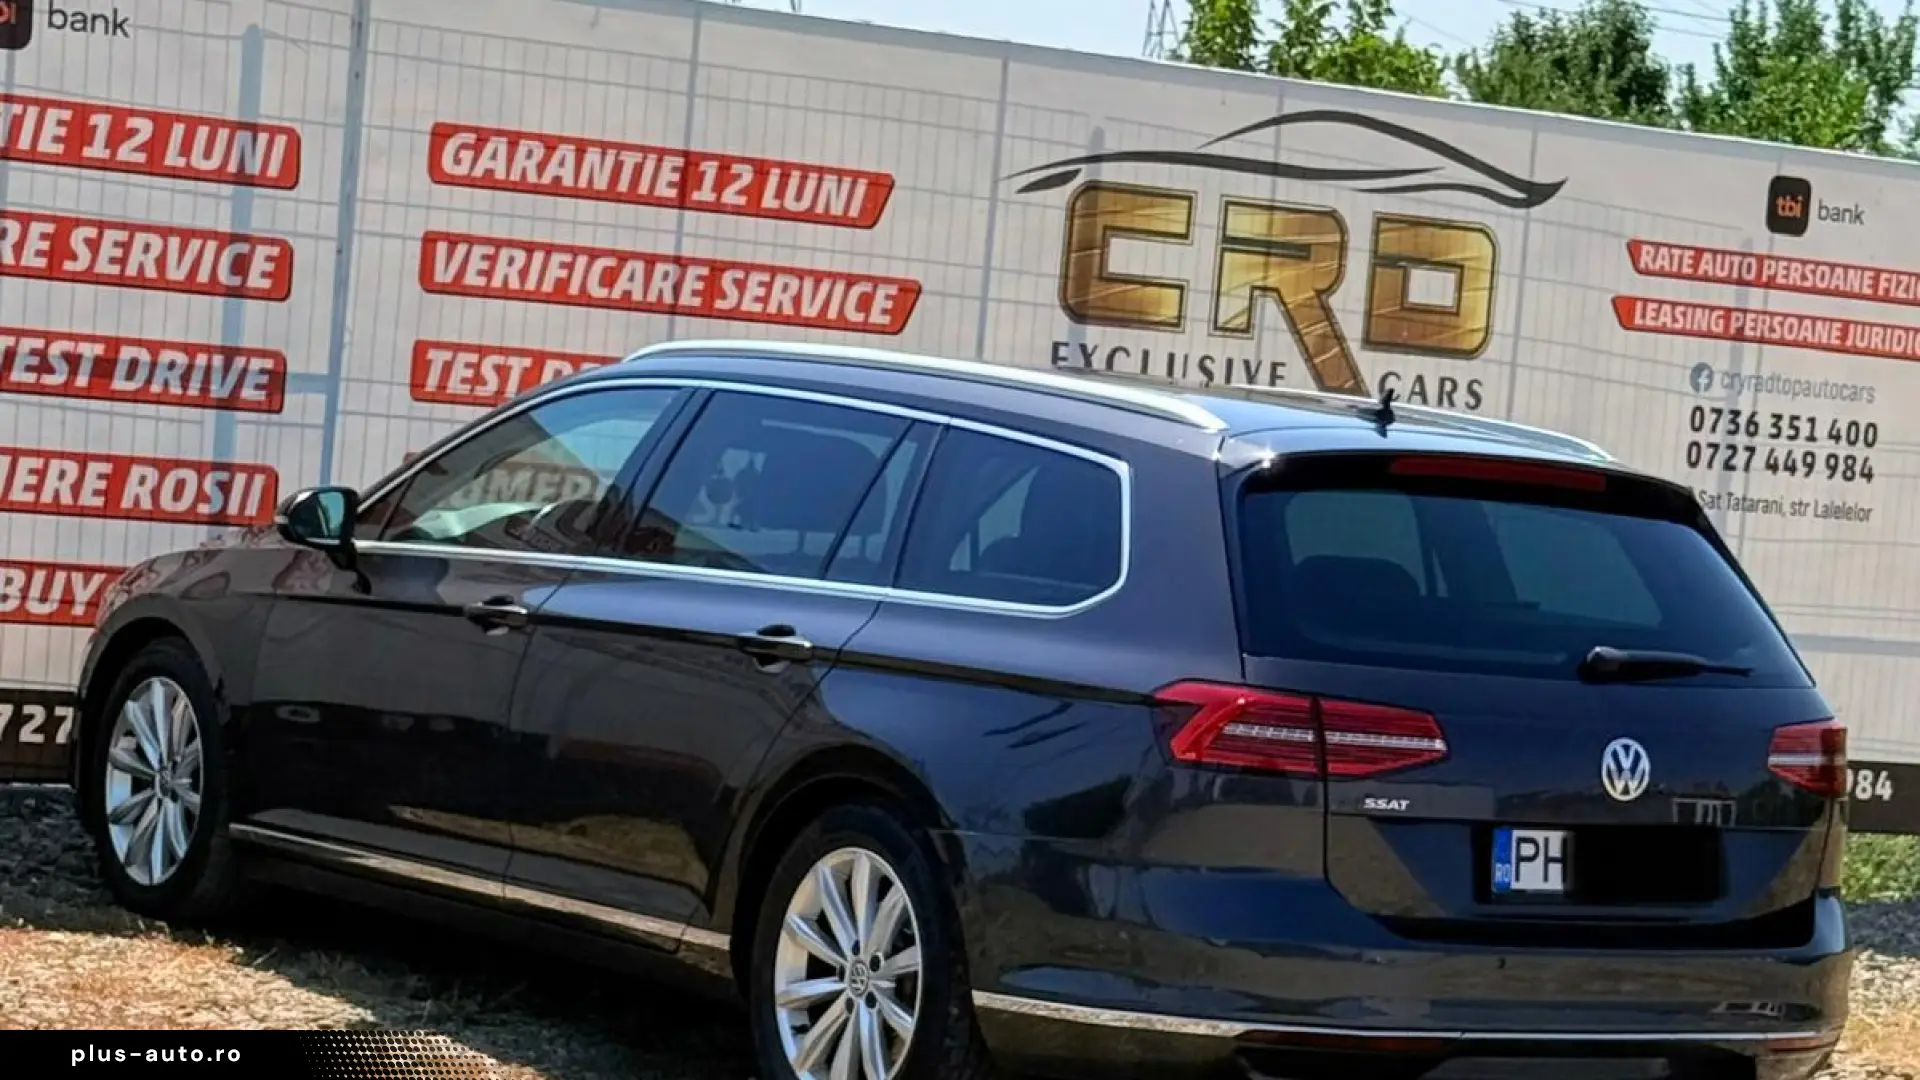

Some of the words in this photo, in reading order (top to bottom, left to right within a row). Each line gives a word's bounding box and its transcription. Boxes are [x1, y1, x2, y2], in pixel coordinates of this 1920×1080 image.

[47, 0, 130, 38] bank
[82, 113, 154, 164] 12
[164, 122, 289, 178] LUNI
[441, 132, 686, 198] GARANTIE
[691, 160, 753, 206] 12
[760, 168, 868, 218] LUNI
[1775, 195, 1804, 218] tbi
[1818, 198, 1865, 226] bank
[62, 225, 281, 289] SERVICE
[1639, 245, 1696, 275] RATE
[1698, 252, 1757, 280] AUTO
[1761, 259, 1875, 295] PERSOANE
[1877, 272, 1920, 300] FIZI
[434, 241, 711, 307] VERIFICARE
[716, 268, 899, 325] SERVICE
[1633, 301, 1726, 335] LEASING
[1729, 312, 1843, 345] PERSOANE
[108, 345, 274, 401] DRIVE
[424, 348, 533, 398] TEST
[1378, 371, 1484, 411] CARS
[1690, 405, 1760, 438] 0736
[1767, 412, 1818, 443] 351
[1827, 418, 1878, 448] 400
[0, 455, 113, 507] ERE
[120, 463, 267, 517] ROSII
[1686, 441, 1756, 473] 0727
[1764, 447, 1816, 479] 449
[1825, 453, 1875, 484] 984
[1698, 489, 1721, 511] Sat
[1789, 499, 1811, 518] str
[0, 567, 107, 616] BUY
[1363, 797, 1410, 812] SSAT
[1515, 836, 1568, 883] PH
